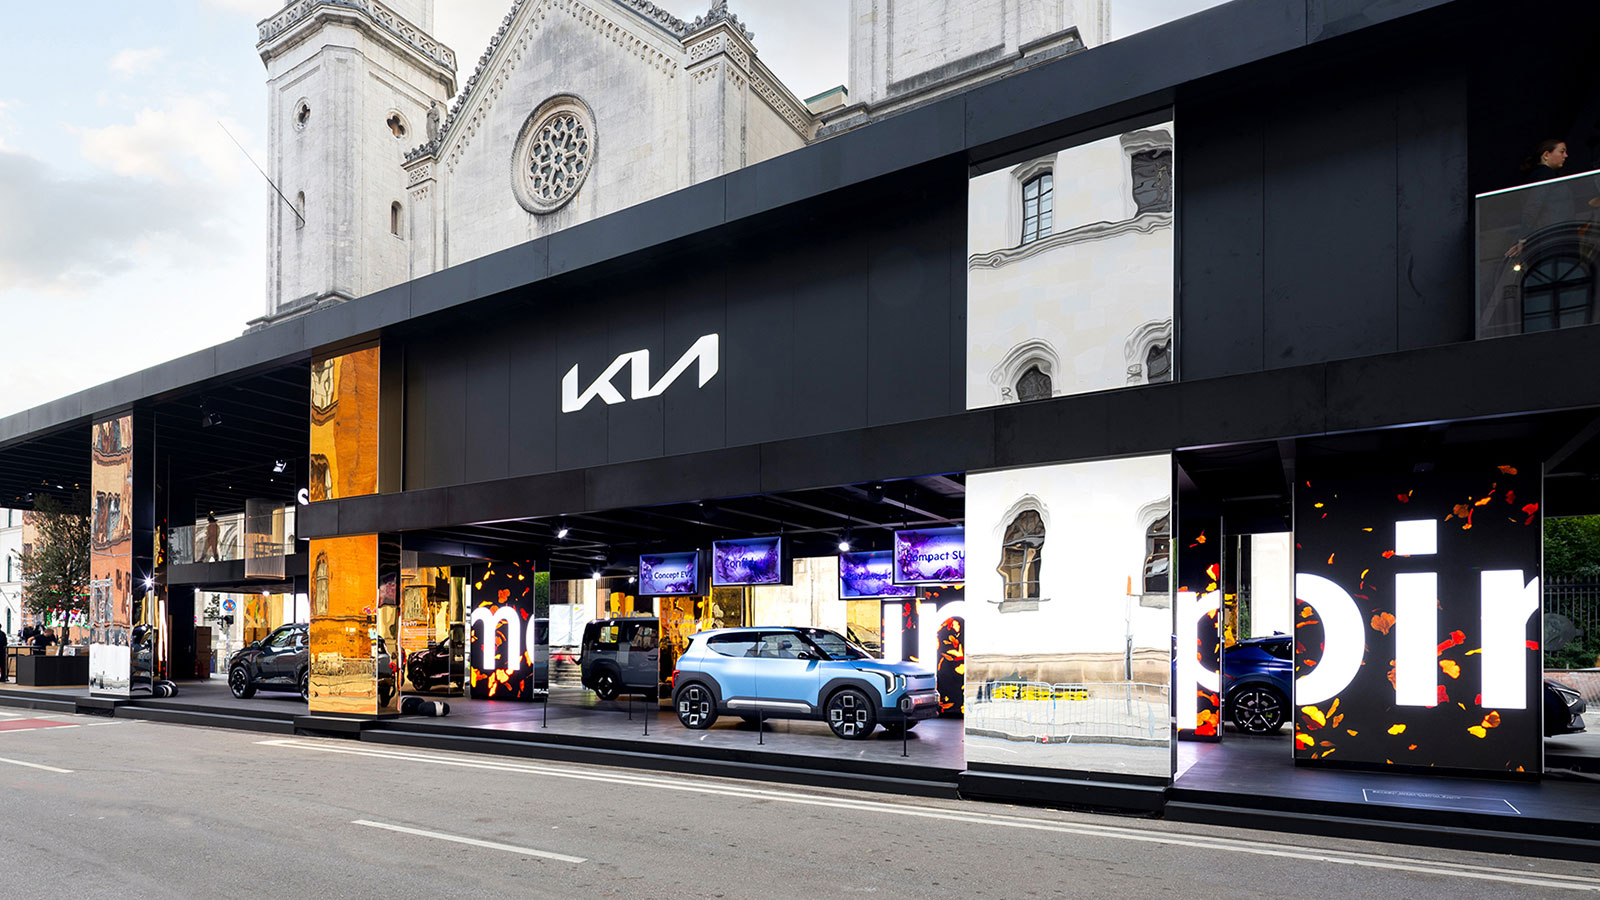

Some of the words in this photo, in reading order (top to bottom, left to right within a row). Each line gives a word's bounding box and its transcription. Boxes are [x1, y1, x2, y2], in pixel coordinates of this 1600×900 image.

[562, 333, 719, 413] KIA
[906, 551, 949, 563] Compact
[654, 571, 680, 580] Concept
